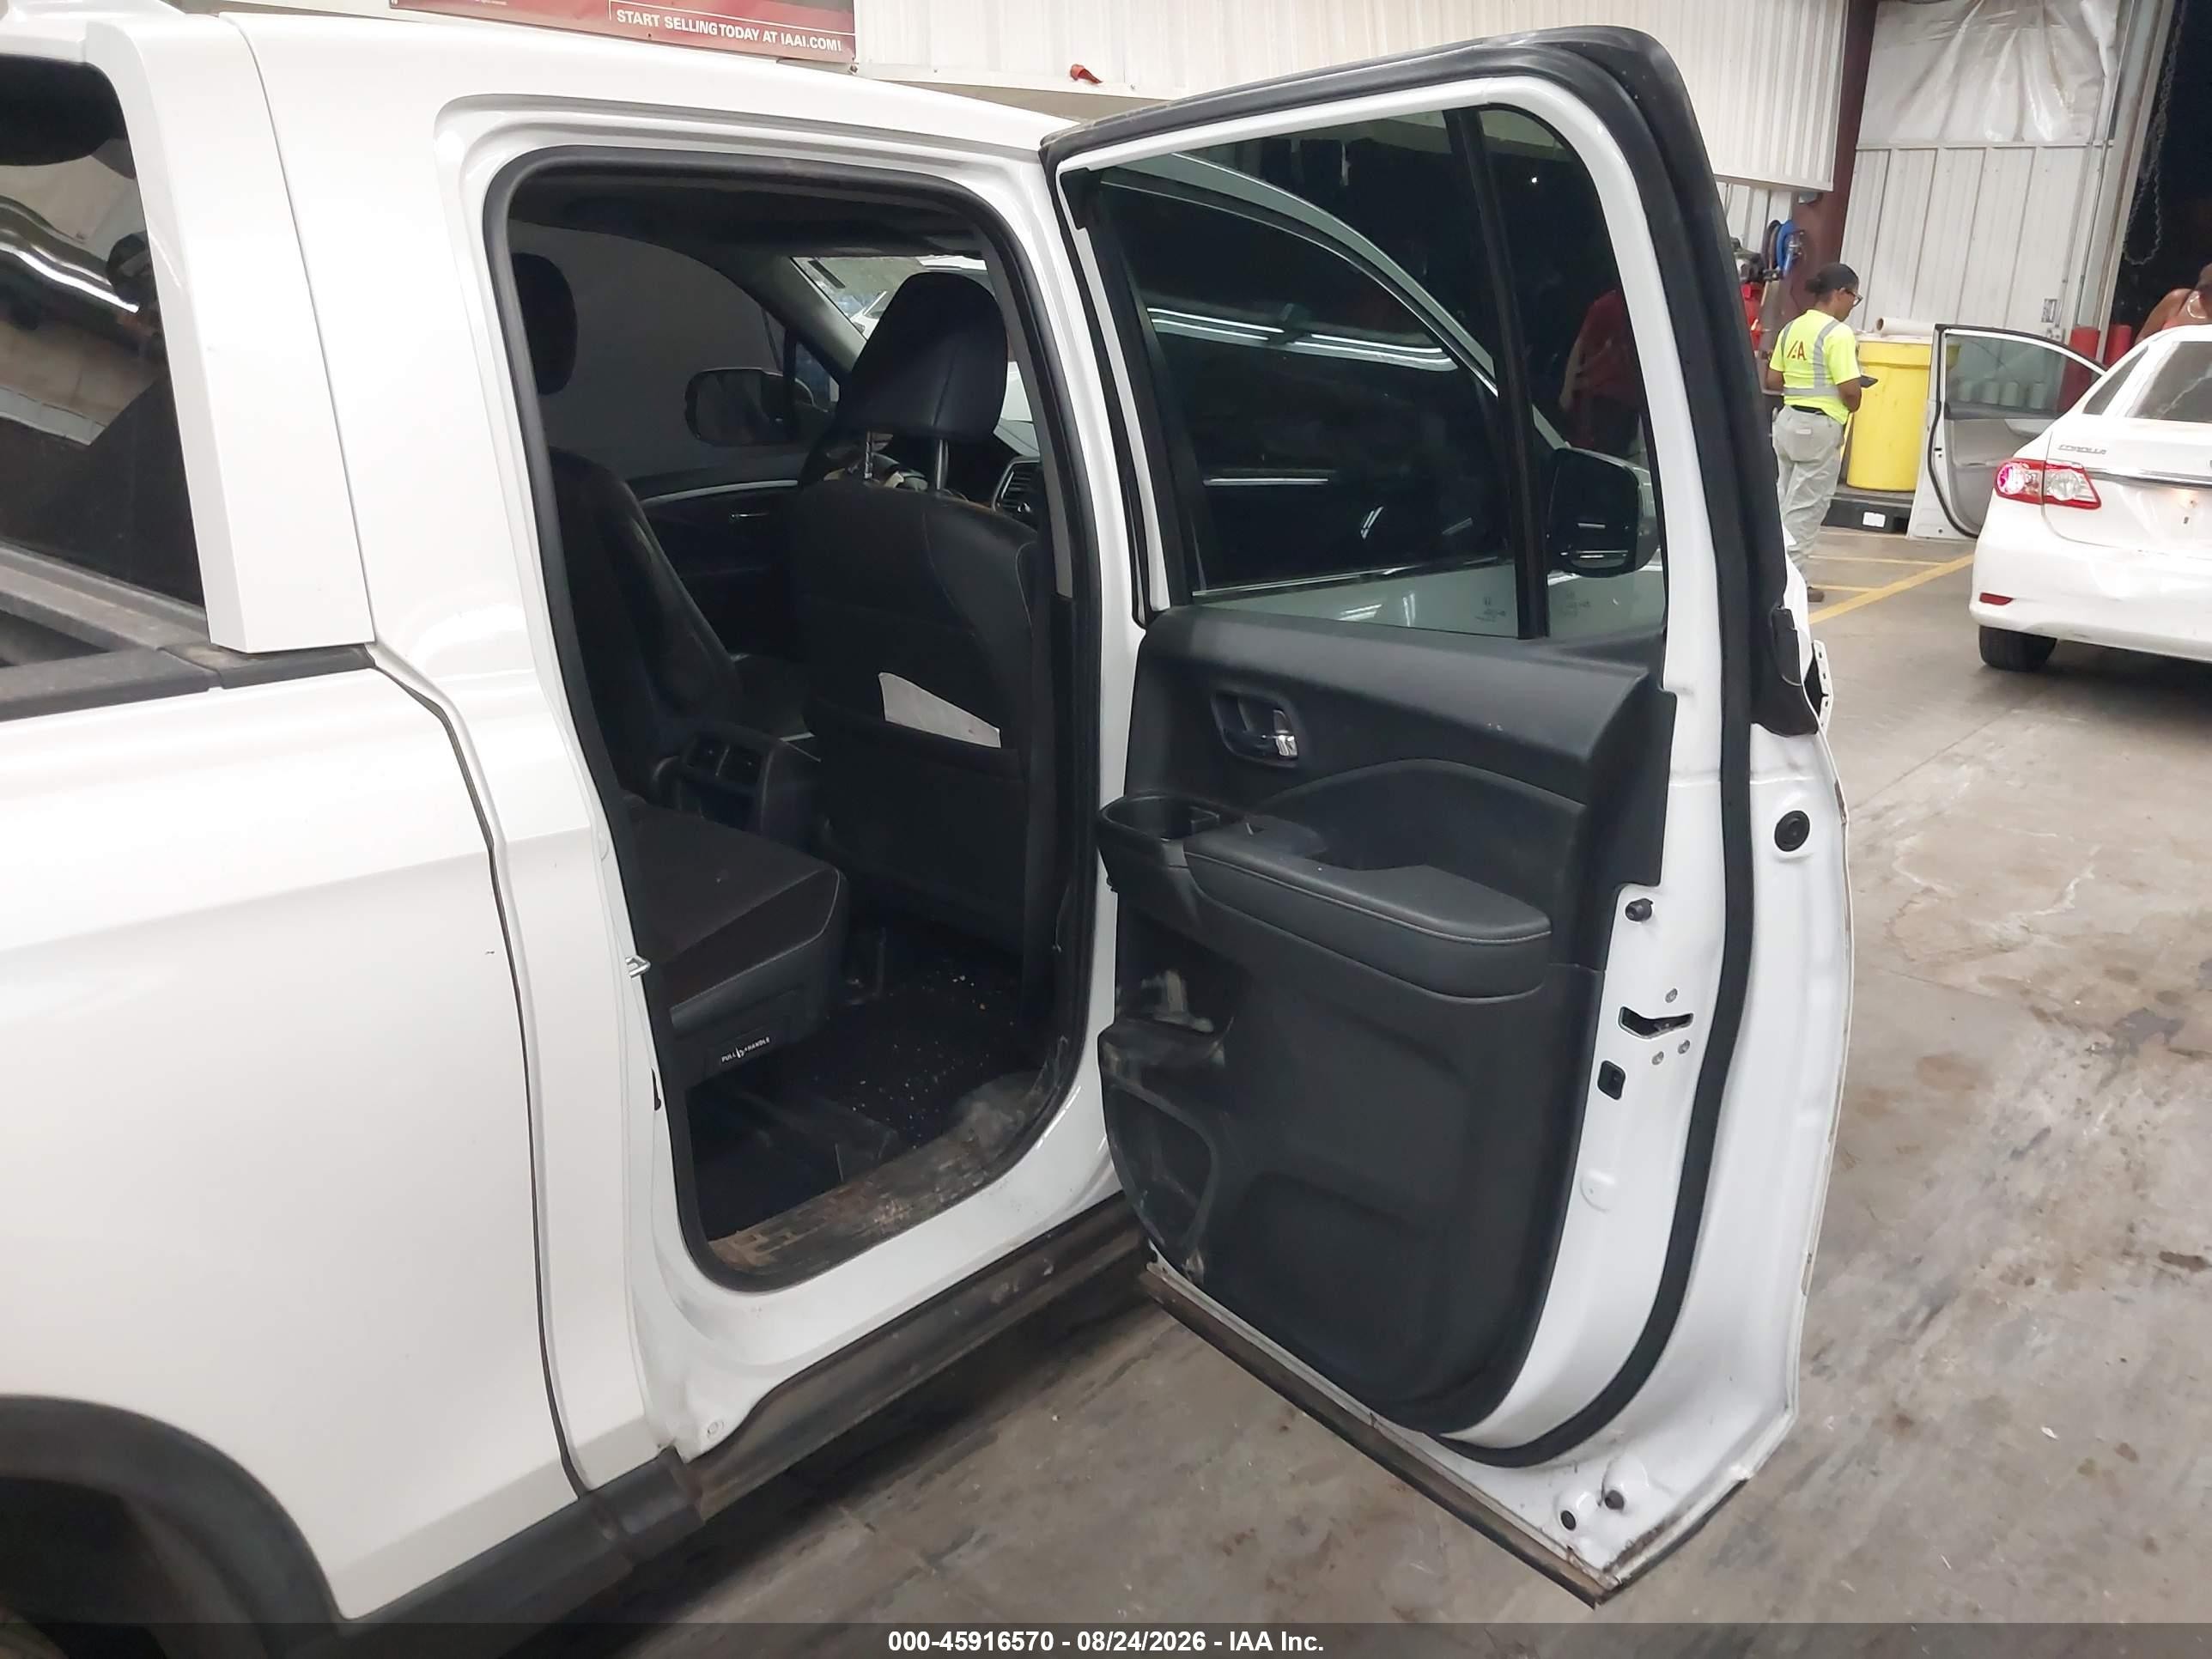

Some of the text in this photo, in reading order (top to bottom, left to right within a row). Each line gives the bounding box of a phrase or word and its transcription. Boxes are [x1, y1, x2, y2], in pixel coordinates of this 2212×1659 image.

[617, 9, 842, 52] START SELLING TODAY AT IAAI.COM!
[721, 1036, 770, 1063] PULL HANDLE
